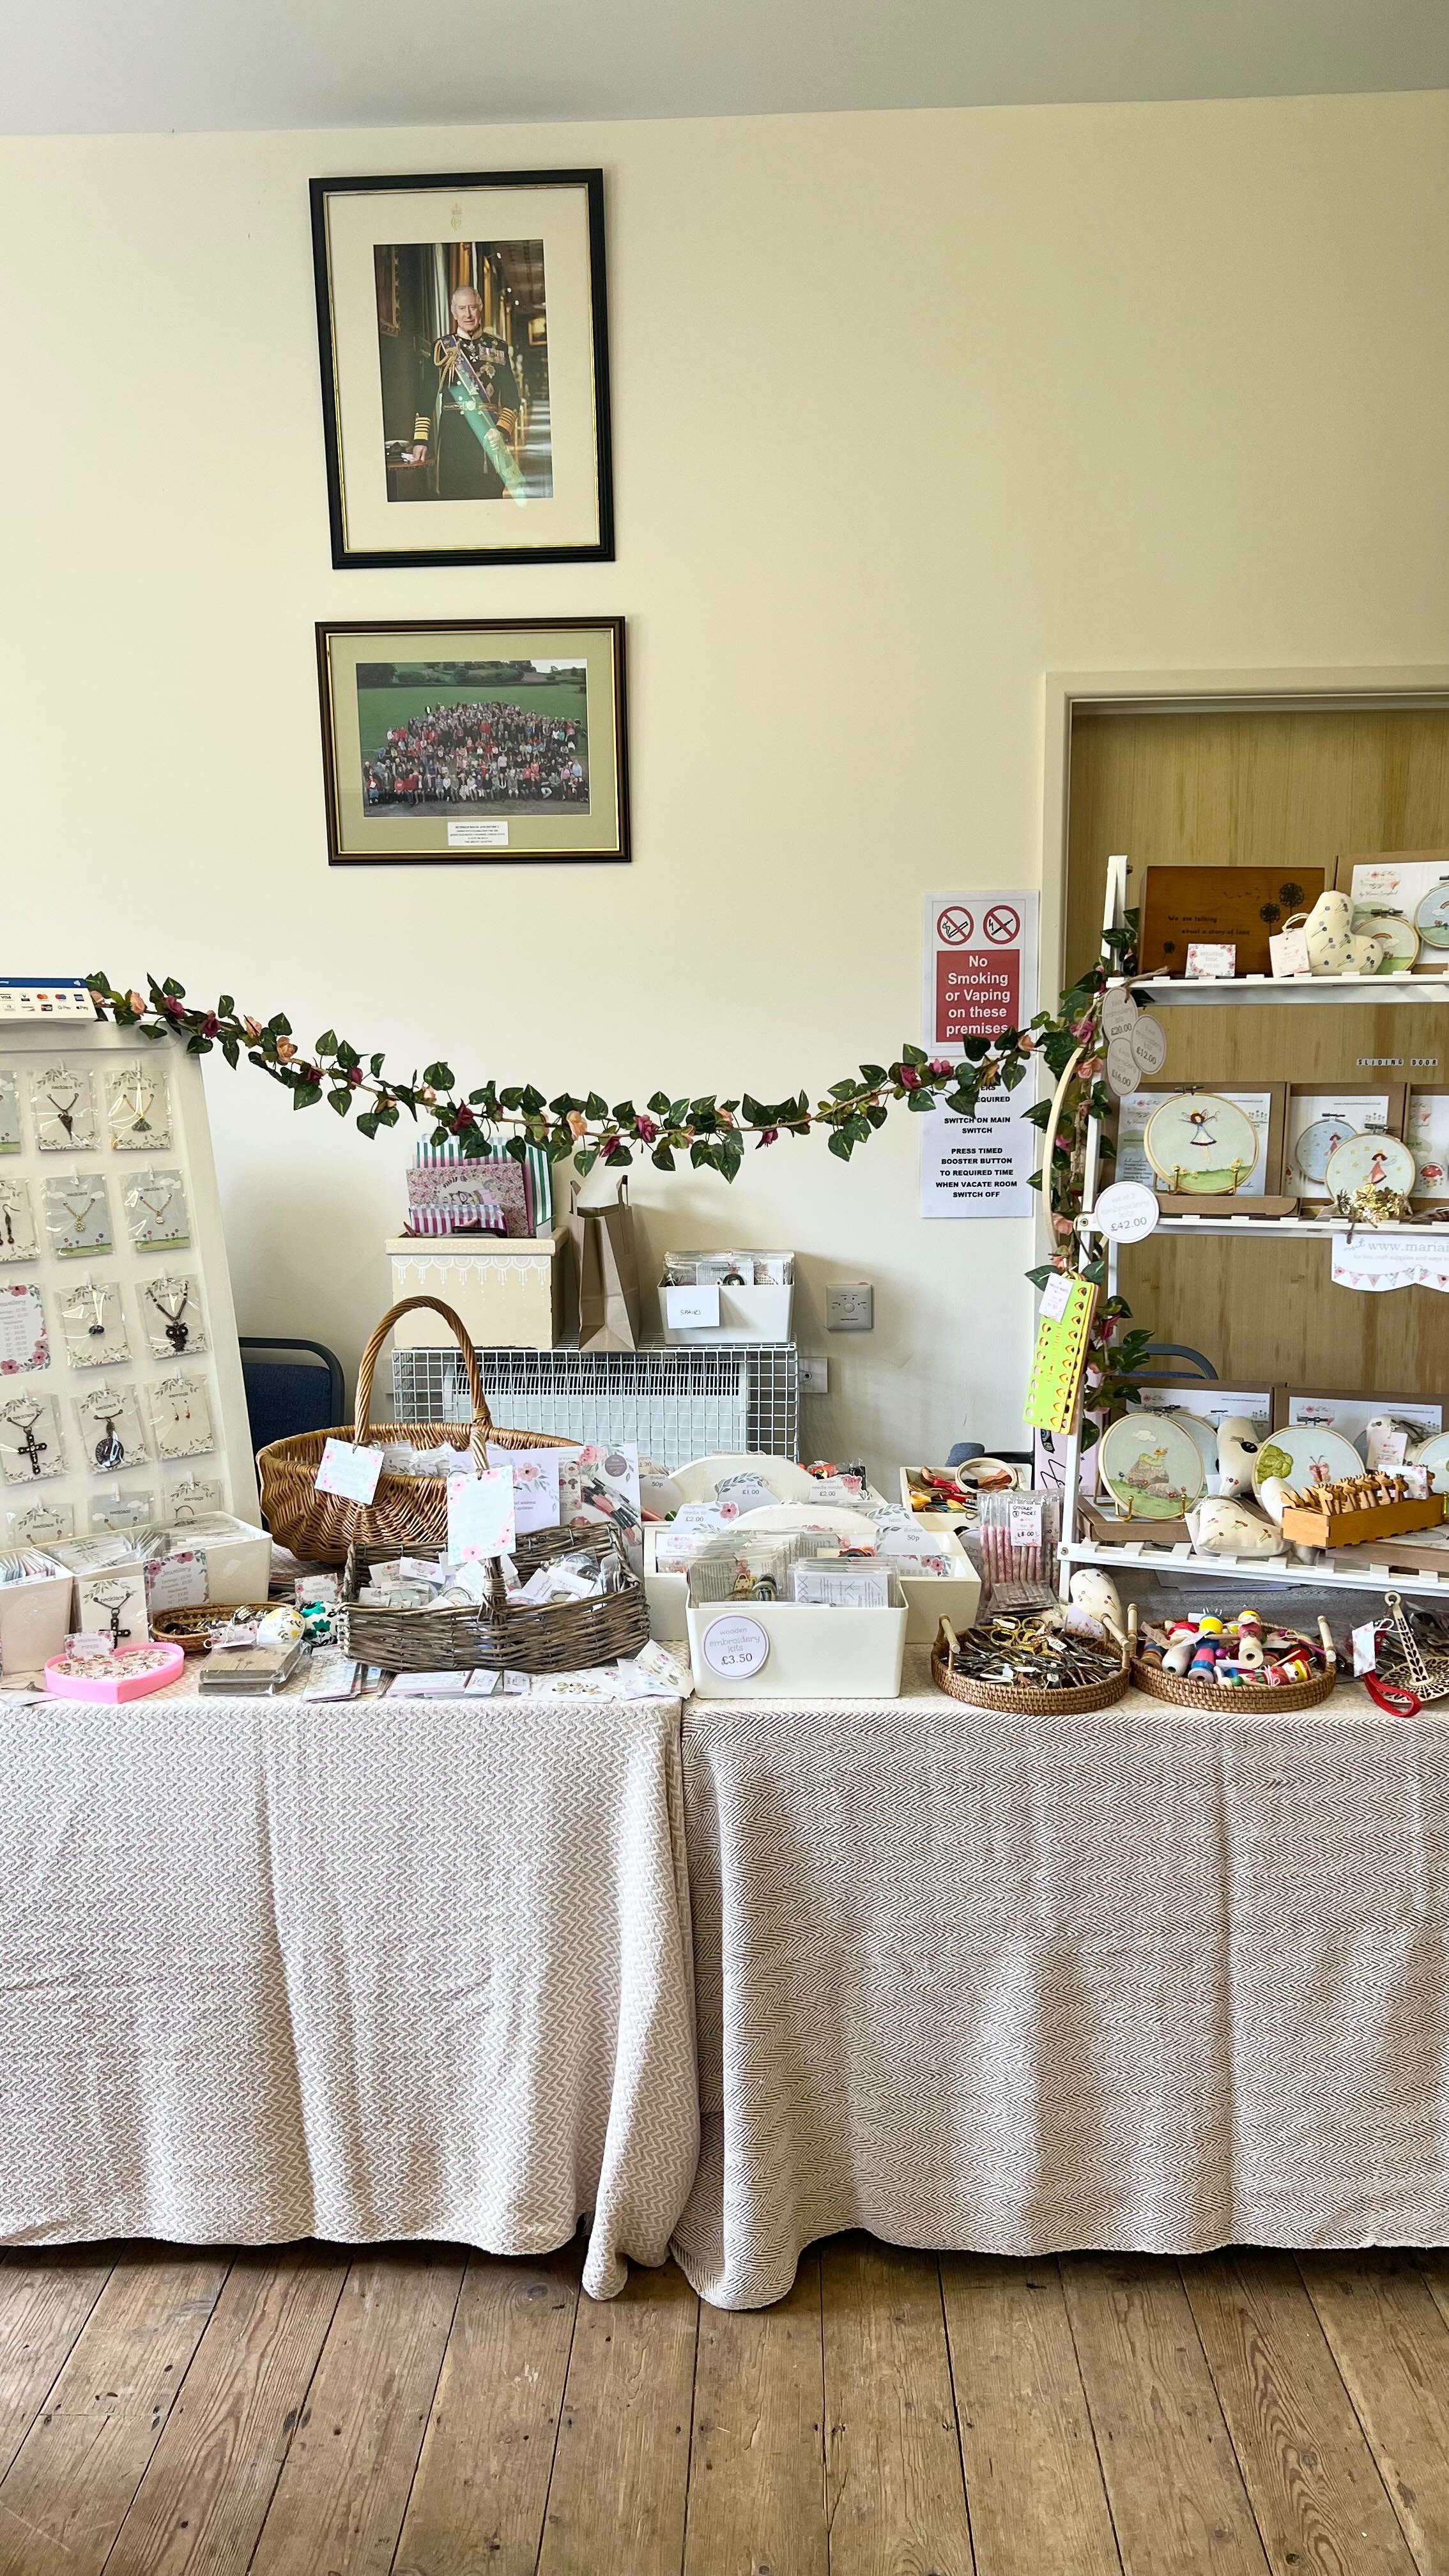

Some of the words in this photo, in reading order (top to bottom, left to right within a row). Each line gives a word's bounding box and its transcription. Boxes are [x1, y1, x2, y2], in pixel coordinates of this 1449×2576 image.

[969, 955, 988, 967] No
[947, 972, 1008, 986] Smoking
[945, 992, 960, 1001] or
[963, 988, 1010, 1004] Vaping
[948, 1008, 965, 1018] on
[969, 1006, 1007, 1018] these
[946, 1022, 1008, 1037] premises
[1110, 1023, 1132, 1036] £20.00
[1136, 1046, 1157, 1065] £12.00
[1111, 1069, 1131, 1087] £16.00
[1111, 1217, 1147, 1232] £42.00
[305, 1586, 331, 1595] magnets
[709, 1636, 760, 1647] embroidery
[727, 1644, 744, 1653] kits
[721, 1653, 753, 1665] £3.50
